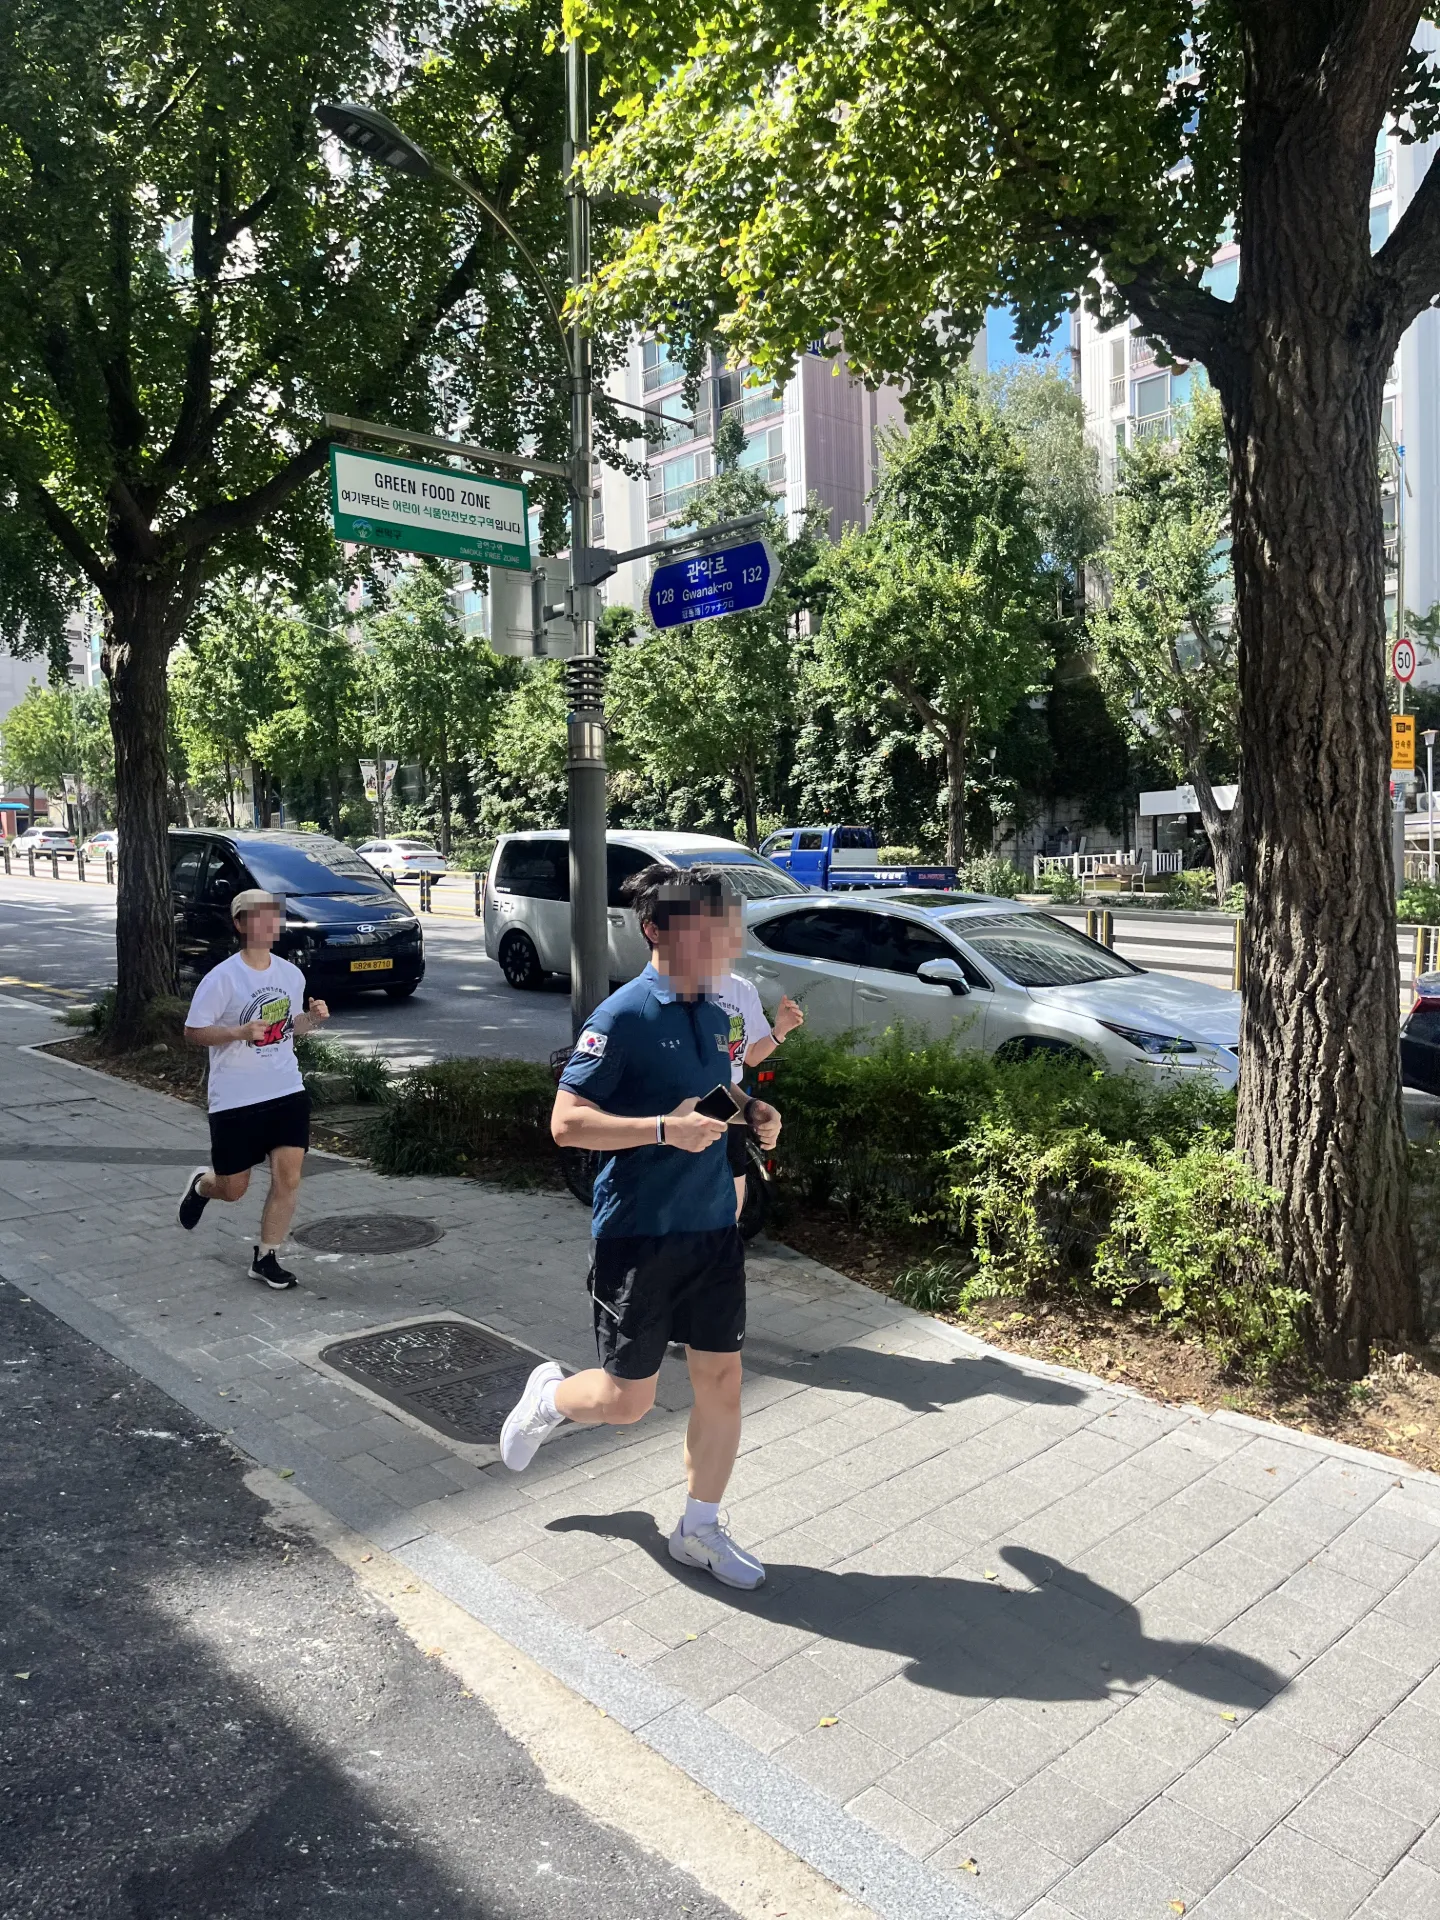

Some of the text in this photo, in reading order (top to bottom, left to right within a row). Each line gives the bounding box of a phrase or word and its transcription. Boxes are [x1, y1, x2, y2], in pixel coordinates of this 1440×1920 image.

[374, 472, 491, 510] GREEN FOOD ZONE
[341, 488, 390, 510] 여기부터는
[392, 499, 421, 516] 어린이
[459, 546, 520, 564] SMOKE FREE ZONE
[476, 540, 503, 552] 금연구역
[686, 556, 728, 584] 관악로
[741, 565, 763, 585] 132
[655, 588, 674, 606] 128
[682, 580, 733, 602] Gwanak-ro
[1397, 651, 1411, 669] 50
